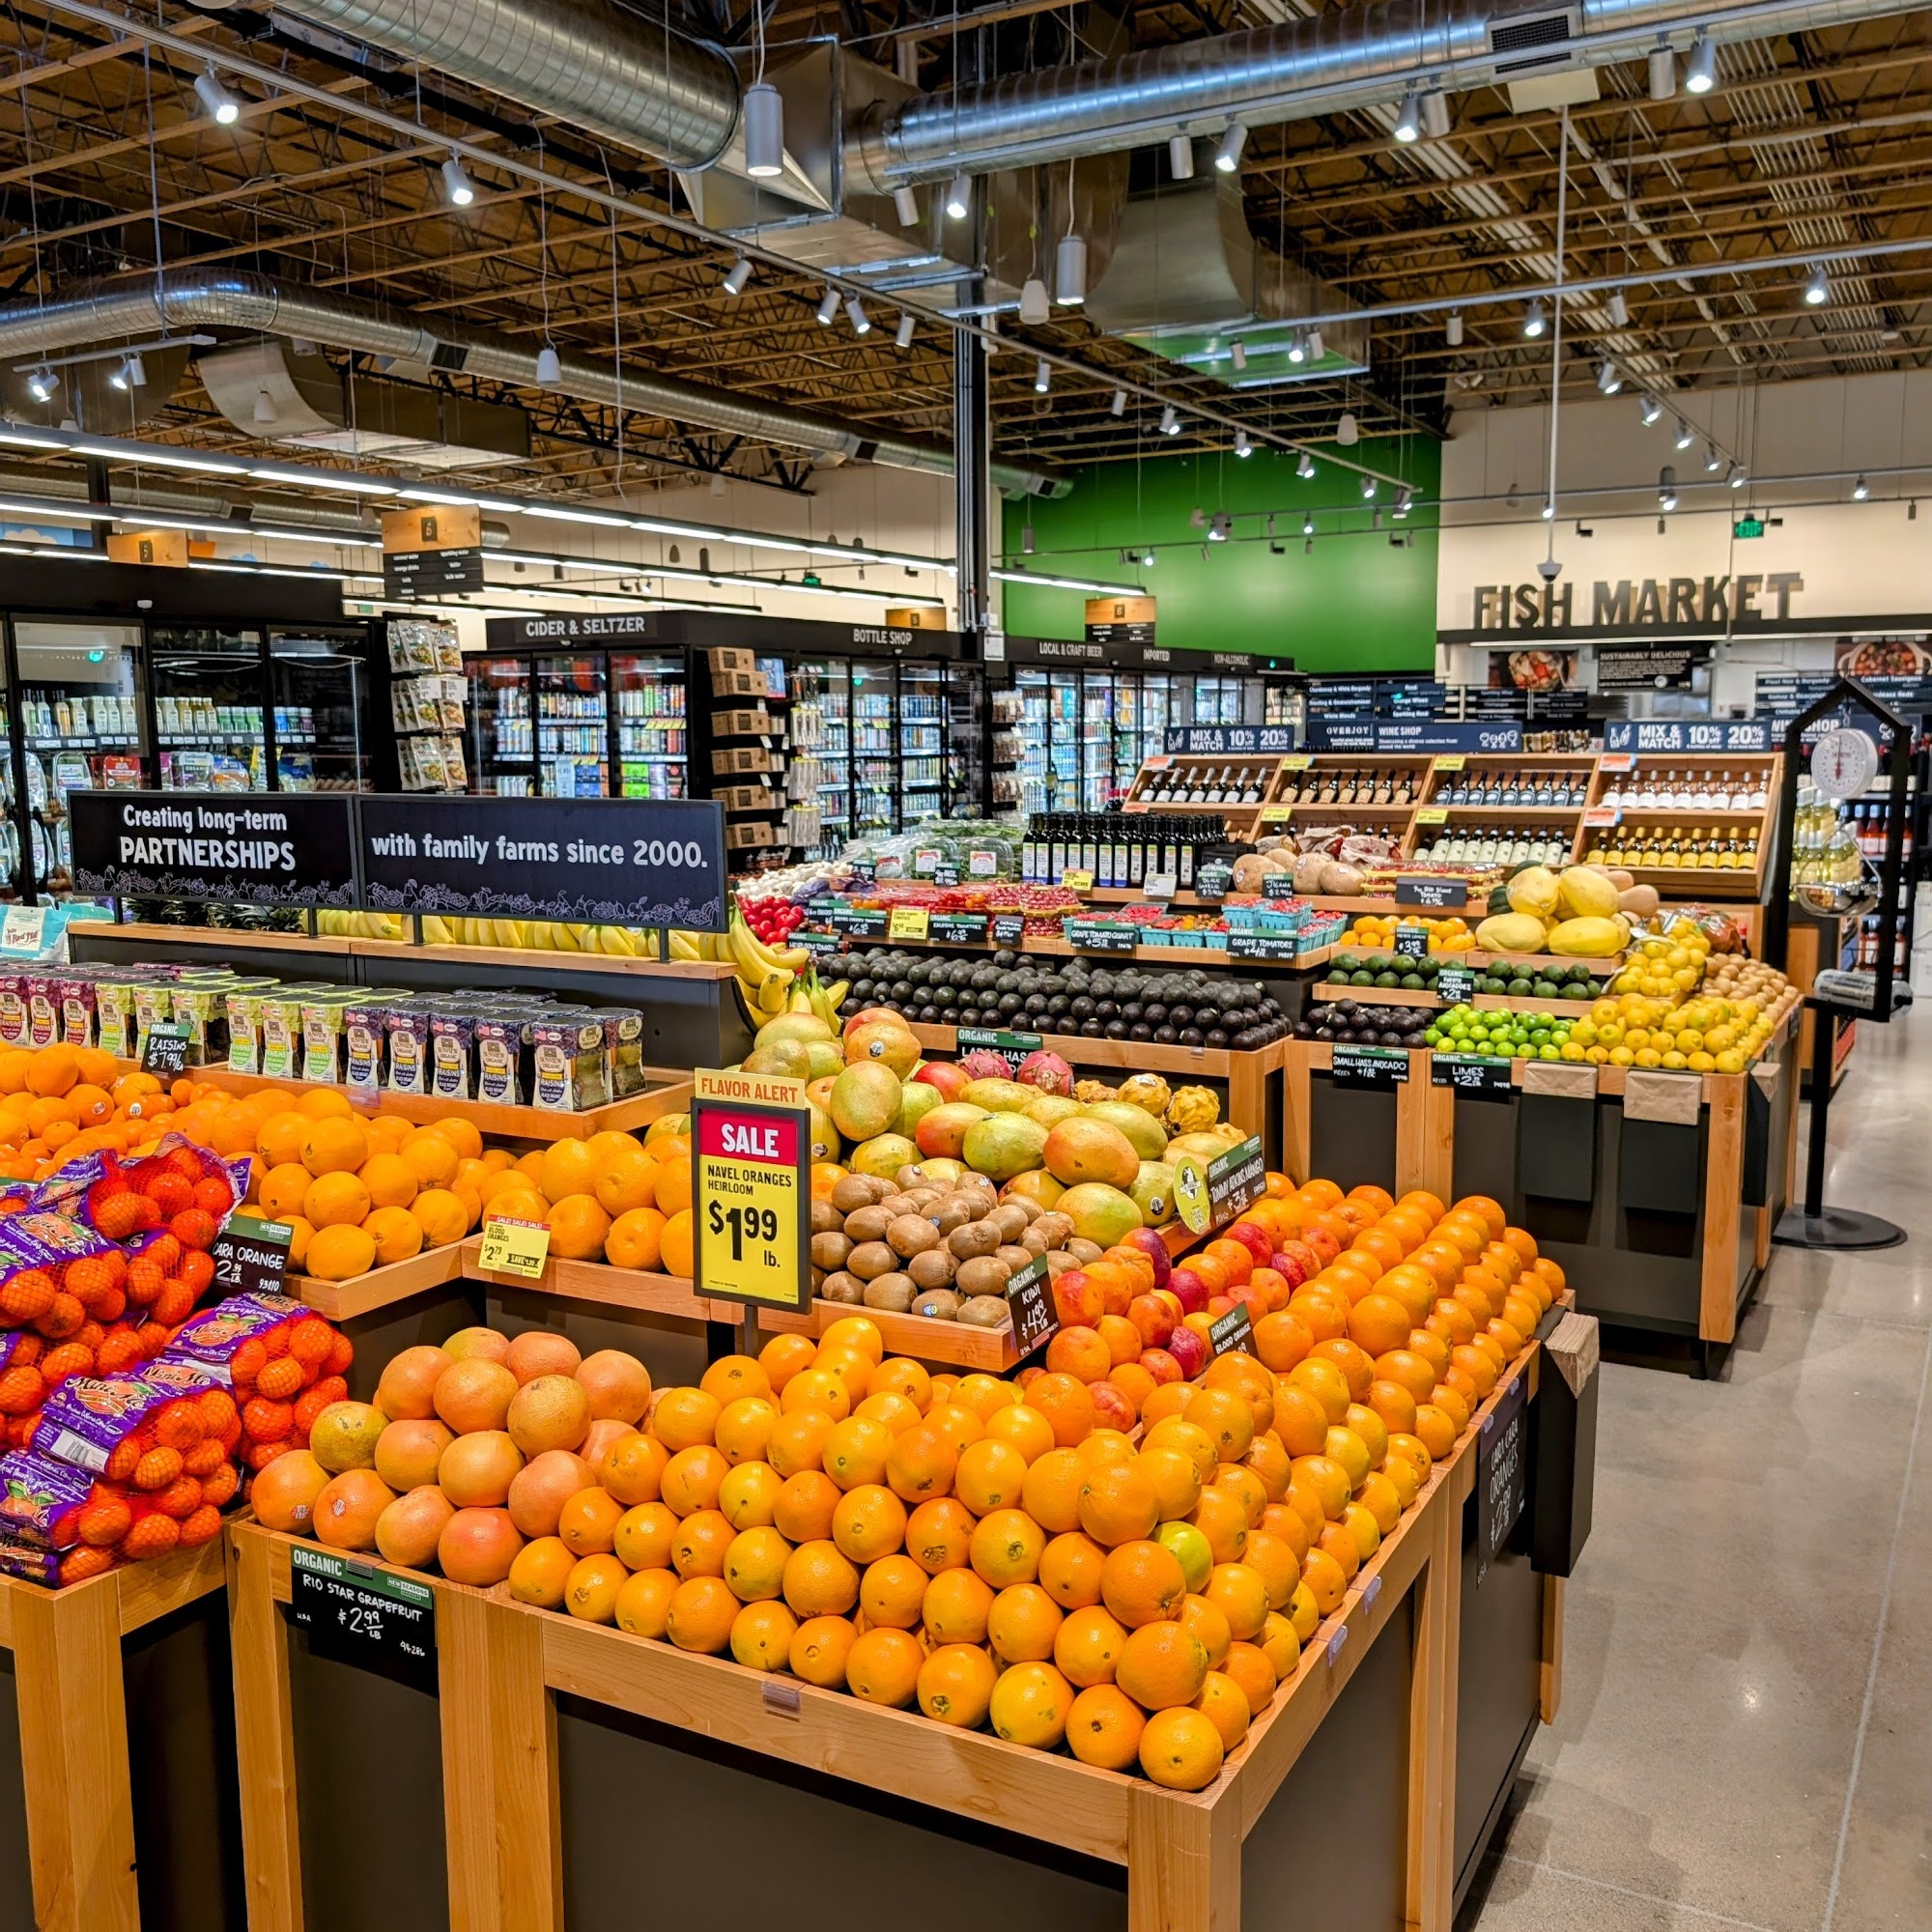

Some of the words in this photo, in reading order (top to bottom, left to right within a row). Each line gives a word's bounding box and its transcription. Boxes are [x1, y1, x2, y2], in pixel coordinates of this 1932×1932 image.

[426, 522, 433, 537] 6
[1473, 582, 1573, 629] FISH
[1593, 572, 1803, 625] MARKET
[526, 619, 566, 637] CIDER
[569, 619, 580, 636] &
[582, 616, 645, 635] SELTZER
[853, 628, 888, 643] BOTTLE
[889, 631, 913, 645] SHOP
[1038, 641, 1061, 655] LOCAL
[1061, 643, 1065, 655] &
[1065, 643, 1086, 657] CRAFT
[1087, 645, 1103, 658] BEER
[1143, 648, 1171, 662] IMPORTED
[1600, 651, 1649, 660] SUSTAINABLY
[1650, 649, 1690, 659] DELICIOUS
[1213, 653, 1249, 667] NON-ALCOHOLIC
[1190, 729, 1210, 741] MIX
[1214, 729, 1224, 741] &
[1229, 729, 1255, 746] 10%
[1260, 729, 1288, 746] 20%
[1326, 726, 1369, 735] OVERJOY
[1378, 726, 1399, 736] WINE
[1401, 726, 1422, 735] SHOP
[1638, 724, 1666, 738] MIX
[1669, 724, 1681, 738] &
[1689, 725, 1721, 745] 10%
[1727, 725, 1764, 745] 20%
[1189, 741, 1224, 751] MATCH
[1638, 738, 1682, 750] MATCH
[124, 804, 192, 834] Creating
[198, 806, 287, 835] long-term
[120, 837, 296, 870] PARTNERSHIPS
[371, 833, 417, 858] with
[423, 833, 489, 865] family
[497, 836, 558, 862] farms
[566, 838, 624, 865] since
[633, 839, 708, 867] 2000.
[13, 933, 24, 943] Red
[1232, 938, 1256, 947] GRAPE
[1259, 939, 1293, 949] TOMATOES
[151, 1023, 179, 1036] ORGANIC
[958, 1029, 997, 1043] ORGANIC
[150, 1037, 186, 1052] RAISINS
[1334, 1045, 1360, 1054] ORGANIC
[1333, 1056, 1354, 1066] SMALL
[1355, 1058, 1372, 1067] HASS
[1372, 1060, 1406, 1070] AVOCADO
[1433, 1054, 1461, 1063] ORGANIC
[485, 1073, 507, 1082] RAISINS
[1452, 1065, 1484, 1077] LIMES
[540, 1079, 564, 1088] RAISINS
[701, 1078, 751, 1098] FLAVOR
[754, 1084, 798, 1103] ALERT
[722, 1123, 780, 1158] SALE
[708, 1164, 740, 1180] NAVEL
[742, 1169, 792, 1187] ORANGES
[1208, 1156, 1229, 1179] ORGANIC
[708, 1179, 753, 1196] HEIRLOOM
[1210, 1179, 1229, 1203] TOMMY
[1229, 1169, 1246, 1192] ATKINS
[1244, 1157, 1264, 1180] MANGO
[270, 1224, 291, 1235] SEASONS
[488, 1226, 505, 1236] BLOOD
[512, 1218, 527, 1227] SALE!
[487, 1233, 509, 1242] ORANGES
[237, 1246, 285, 1269] ORANGE
[511, 1255, 525, 1264] SAVE
[763, 1250, 781, 1267] lb.
[259, 1278, 280, 1292] 93110
[1009, 1265, 1036, 1294] ORGANIC
[1022, 1283, 1041, 1305] KIWI
[1210, 1312, 1237, 1340] ORGANIC
[1215, 1336, 1234, 1354] BLOOD
[1234, 1322, 1251, 1342] ORANGE
[65, 1377, 114, 1396] Mini
[1492, 1439, 1505, 1471] CARA
[1505, 1417, 1519, 1449] CARA
[1490, 1438, 1519, 1504] ORANGES
[294, 1549, 342, 1577] ORGANIC
[387, 1577, 401, 1589] NEW
[401, 1582, 430, 1598] SEASONS
[302, 1574, 323, 1591] RIO
[327, 1582, 355, 1601] STAR
[357, 1592, 423, 1622] GRAPEFRUIT
[369, 1630, 382, 1639] LB
